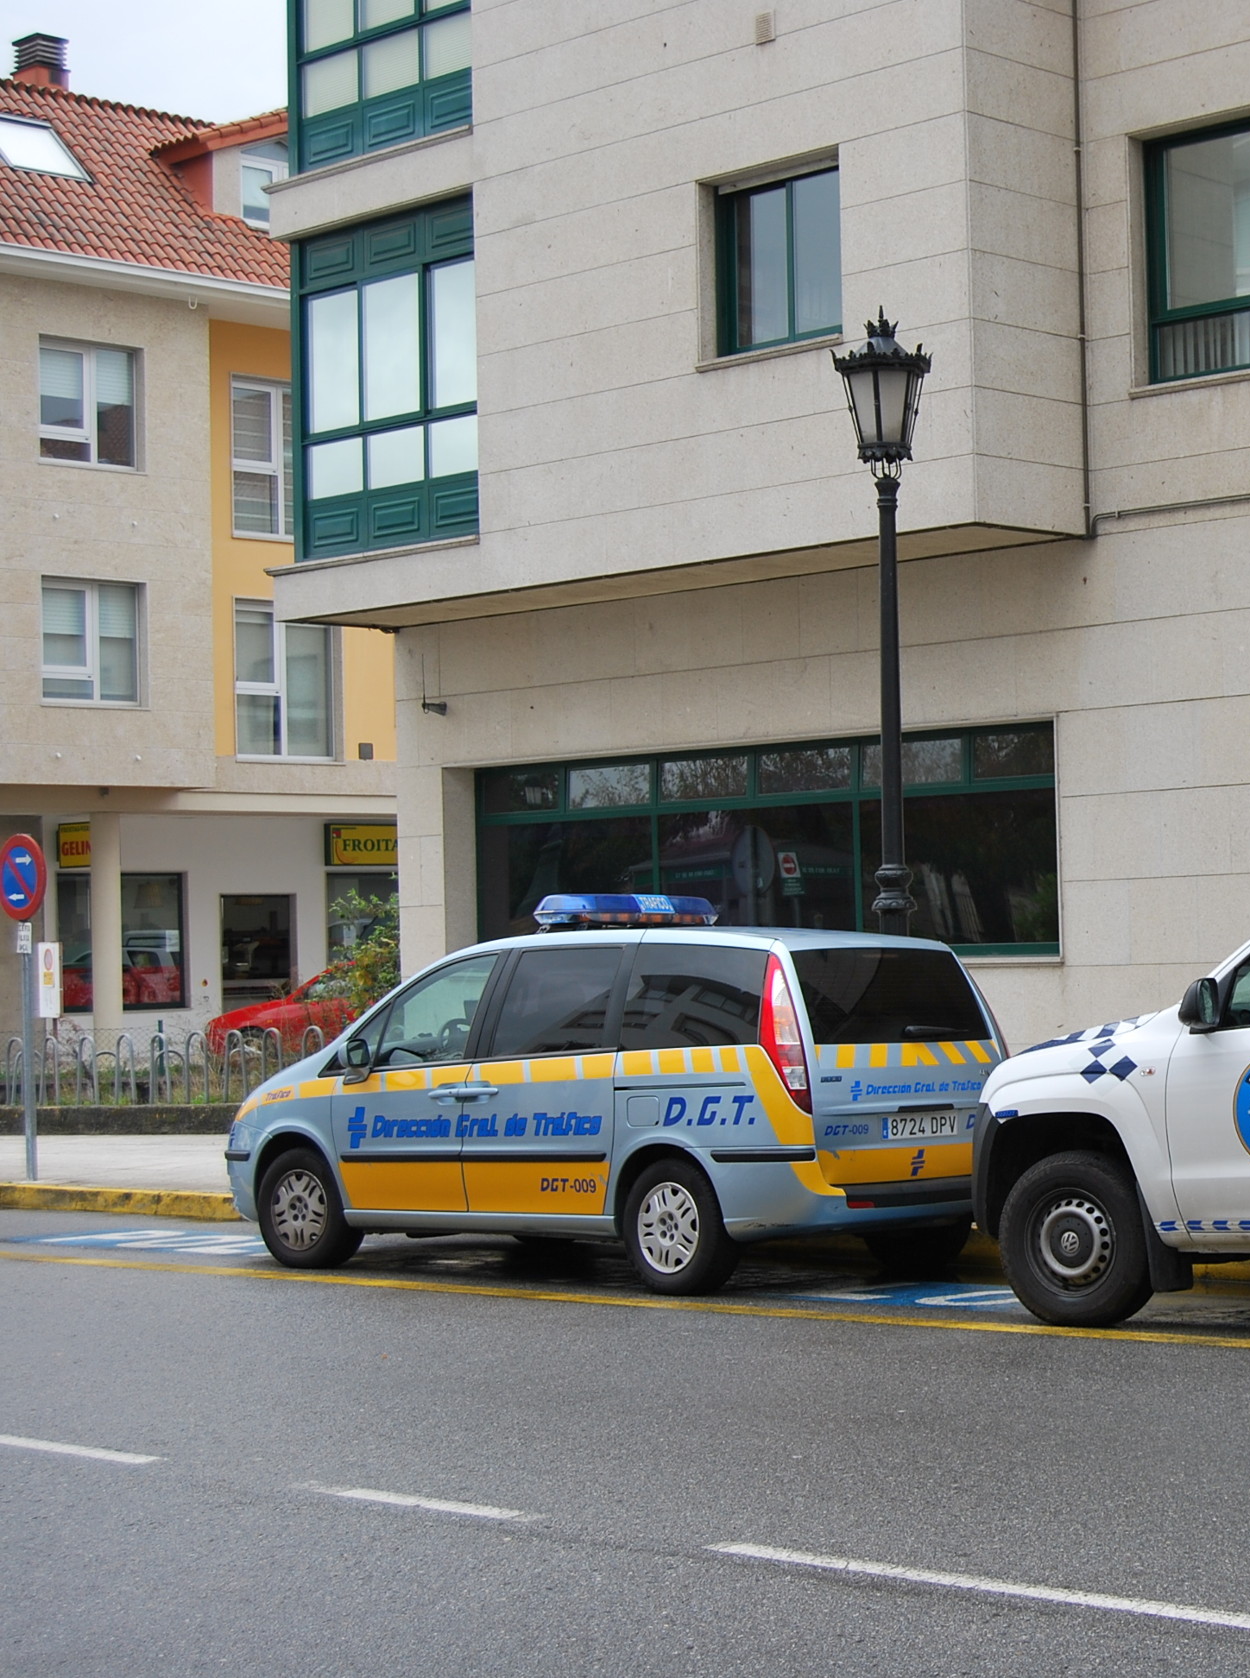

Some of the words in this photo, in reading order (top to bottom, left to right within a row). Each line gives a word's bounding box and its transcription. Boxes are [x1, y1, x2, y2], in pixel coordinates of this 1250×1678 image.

[939, 1081, 950, 1092] de
[663, 1095, 756, 1127] D.G.T.
[371, 1114, 451, 1138] Dirección
[504, 1113, 528, 1137] de
[824, 1124, 869, 1136] DGT-009
[891, 1116, 926, 1136] 8724
[930, 1115, 957, 1135] DPV
[540, 1177, 597, 1194] DGT-009
